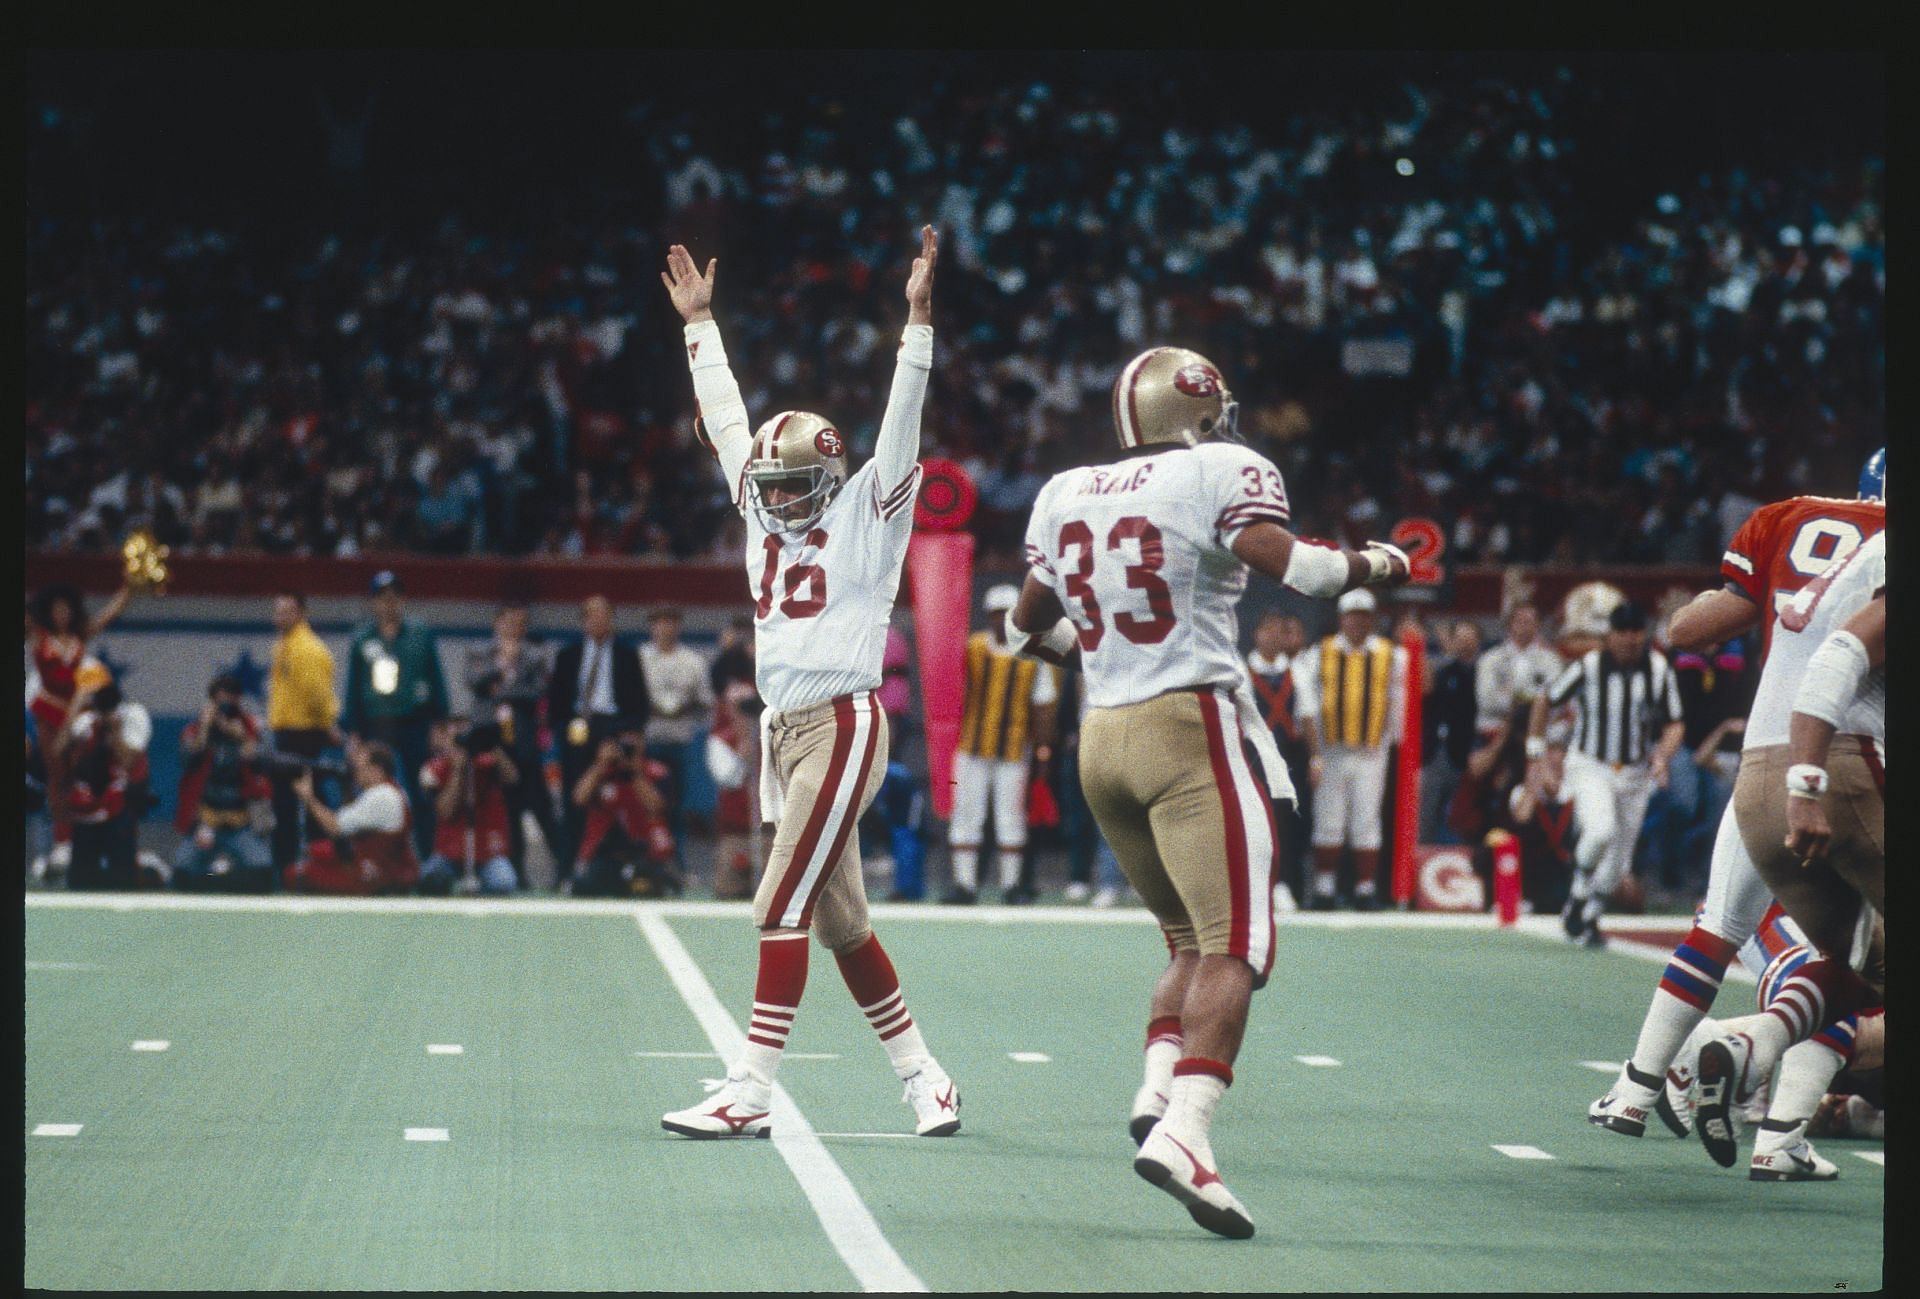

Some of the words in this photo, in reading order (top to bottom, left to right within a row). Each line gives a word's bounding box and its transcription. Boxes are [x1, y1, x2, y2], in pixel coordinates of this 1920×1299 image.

[1242, 466, 1284, 502] 33
[757, 528, 830, 620] 16
[1058, 516, 1177, 652] 33
[1391, 518, 1446, 585] 2
[1774, 516, 1885, 617] 9
